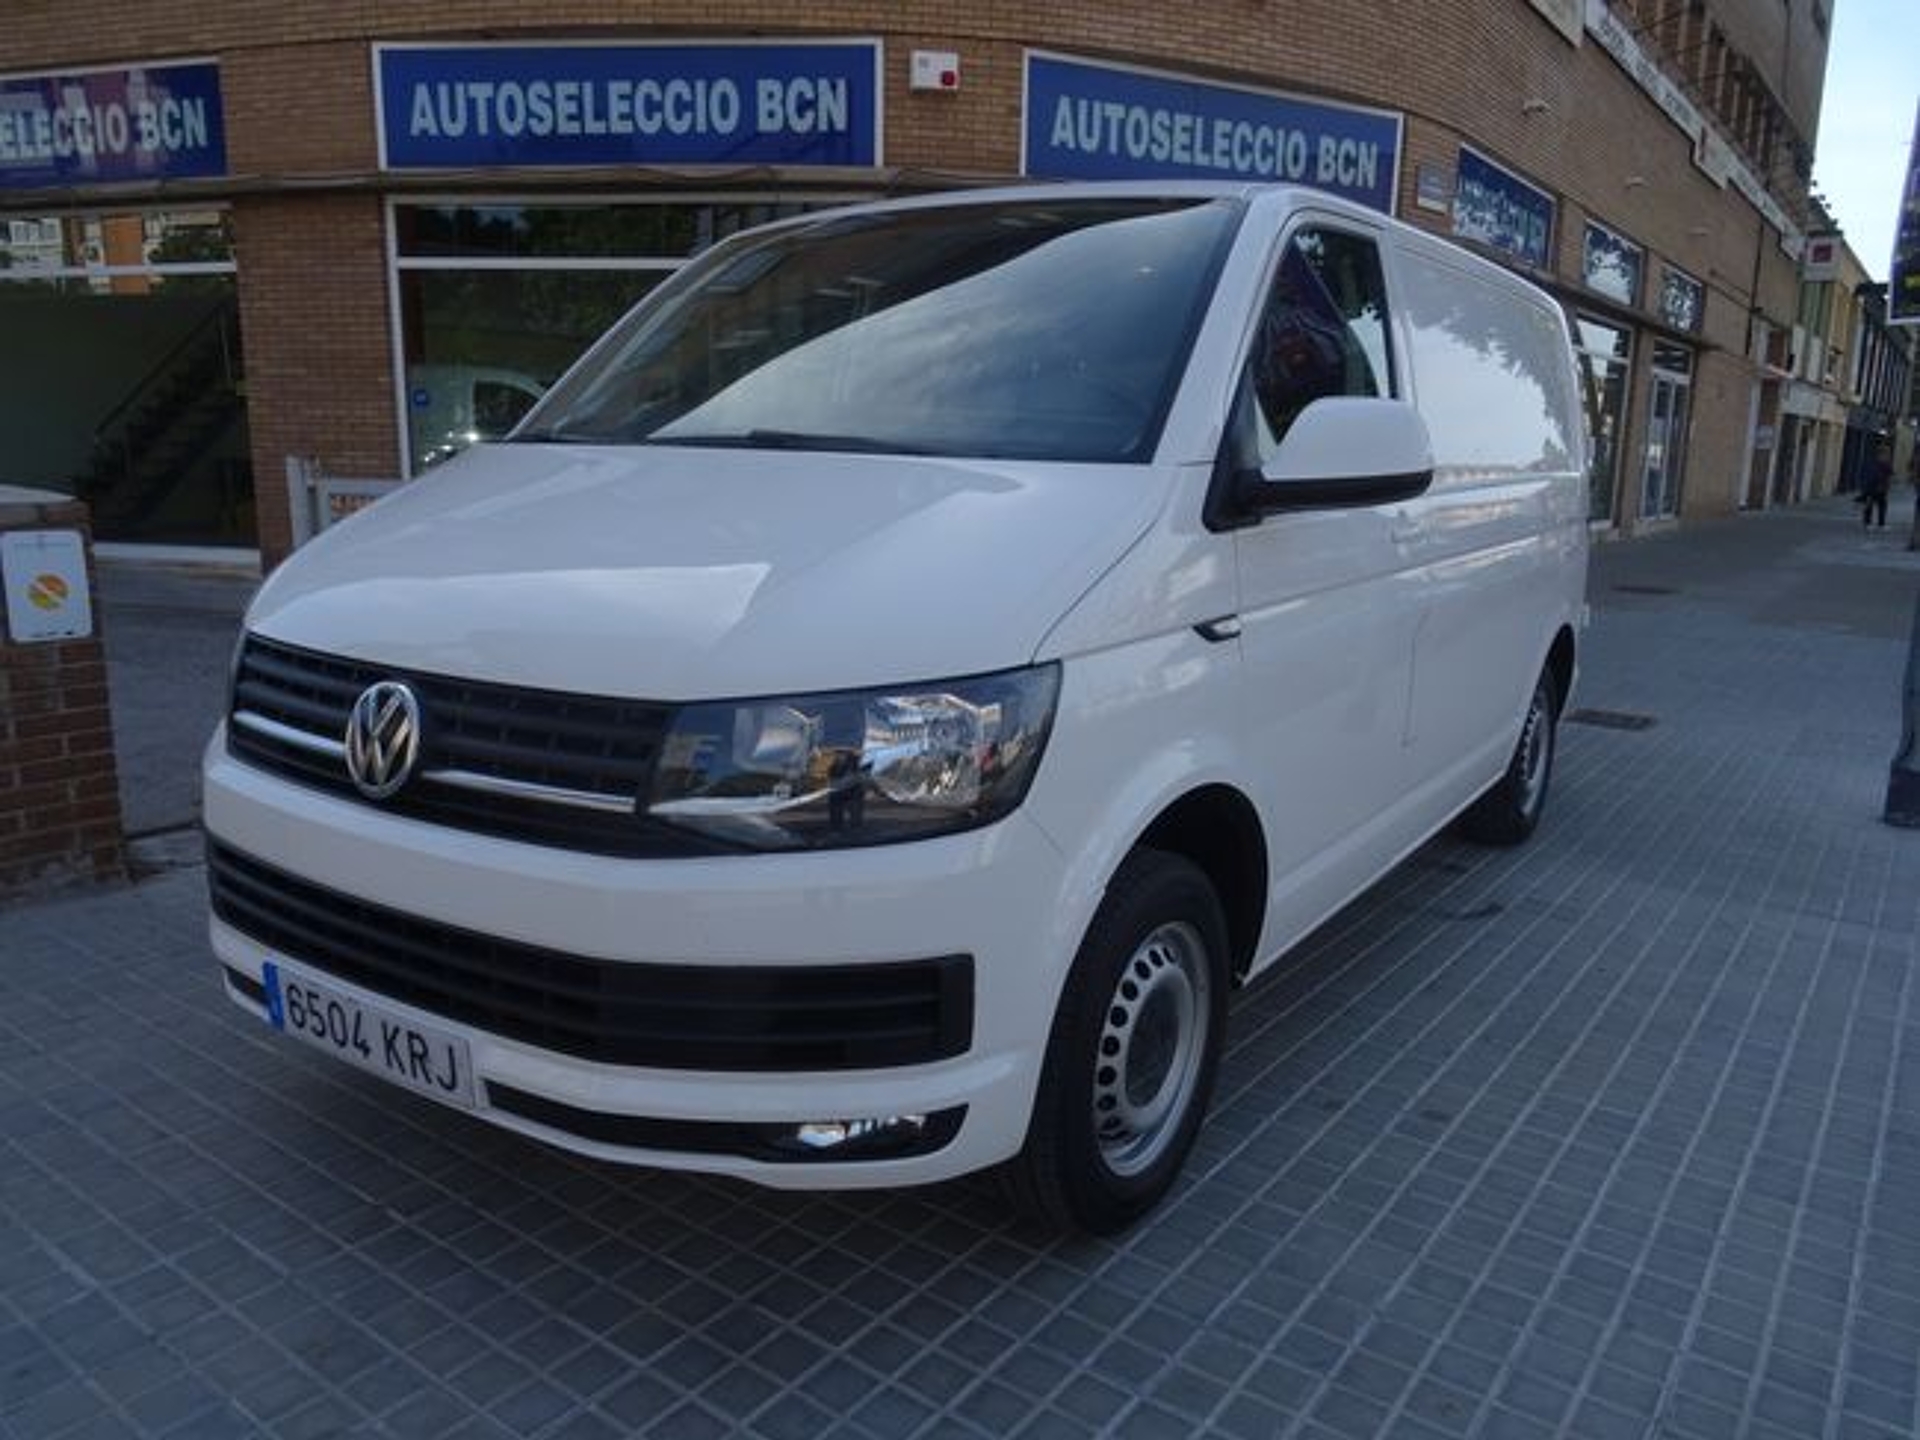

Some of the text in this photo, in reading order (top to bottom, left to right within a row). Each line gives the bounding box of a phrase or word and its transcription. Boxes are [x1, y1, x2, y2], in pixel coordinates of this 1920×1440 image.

[138, 97, 208, 151] BCN
[409, 78, 847, 136] AUTOSELECCIO BCN
[1051, 95, 1306, 179] AUTOSELECCIO
[1317, 135, 1378, 189] BCN
[286, 983, 457, 1091] 6504 KRJ
